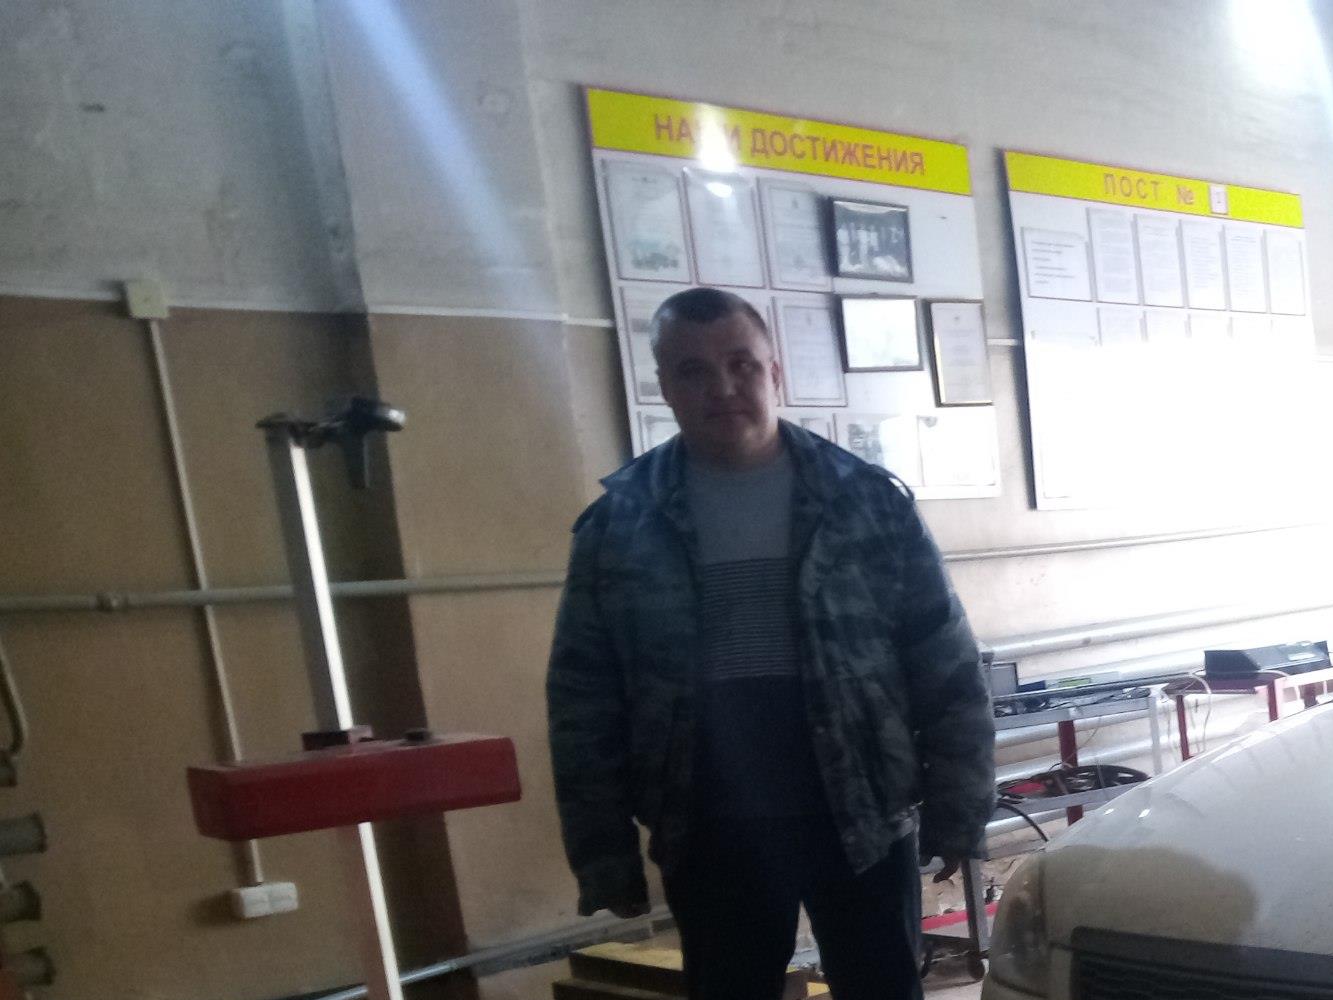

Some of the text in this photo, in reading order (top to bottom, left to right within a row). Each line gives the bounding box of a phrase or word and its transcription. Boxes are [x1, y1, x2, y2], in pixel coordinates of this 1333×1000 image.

[654, 113, 925, 175] НАИ ДОСТИЖЕНИЯ
[1103, 173, 1161, 201] ПОСТ
